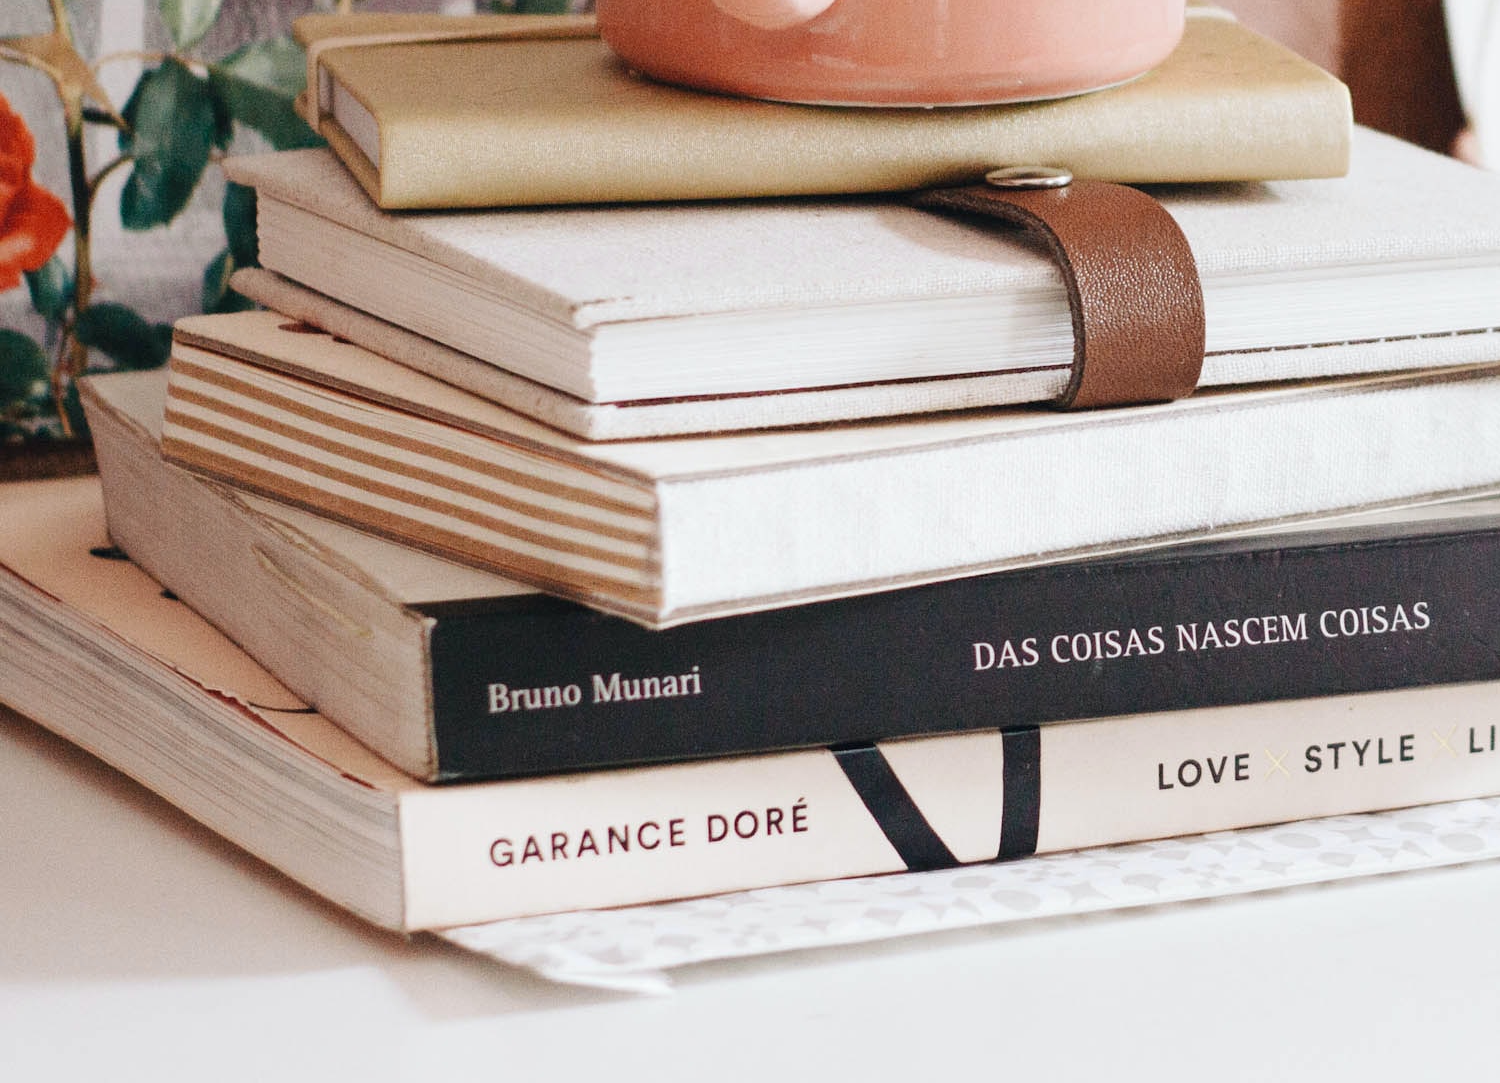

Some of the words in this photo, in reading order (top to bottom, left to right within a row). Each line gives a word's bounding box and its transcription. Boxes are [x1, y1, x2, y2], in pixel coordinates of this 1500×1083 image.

[488, 683, 582, 714] Bruno
[592, 665, 702, 704] Munari
[972, 637, 1040, 671] DAS
[1050, 625, 1165, 664] COISAS
[1175, 612, 1309, 652] NASCEM
[1319, 601, 1431, 638] COISAS
[1158, 752, 1250, 791] LOVE
[1304, 733, 1415, 774] STYLE
[489, 817, 686, 868] GARANCE
[707, 798, 810, 843] DORÉ
